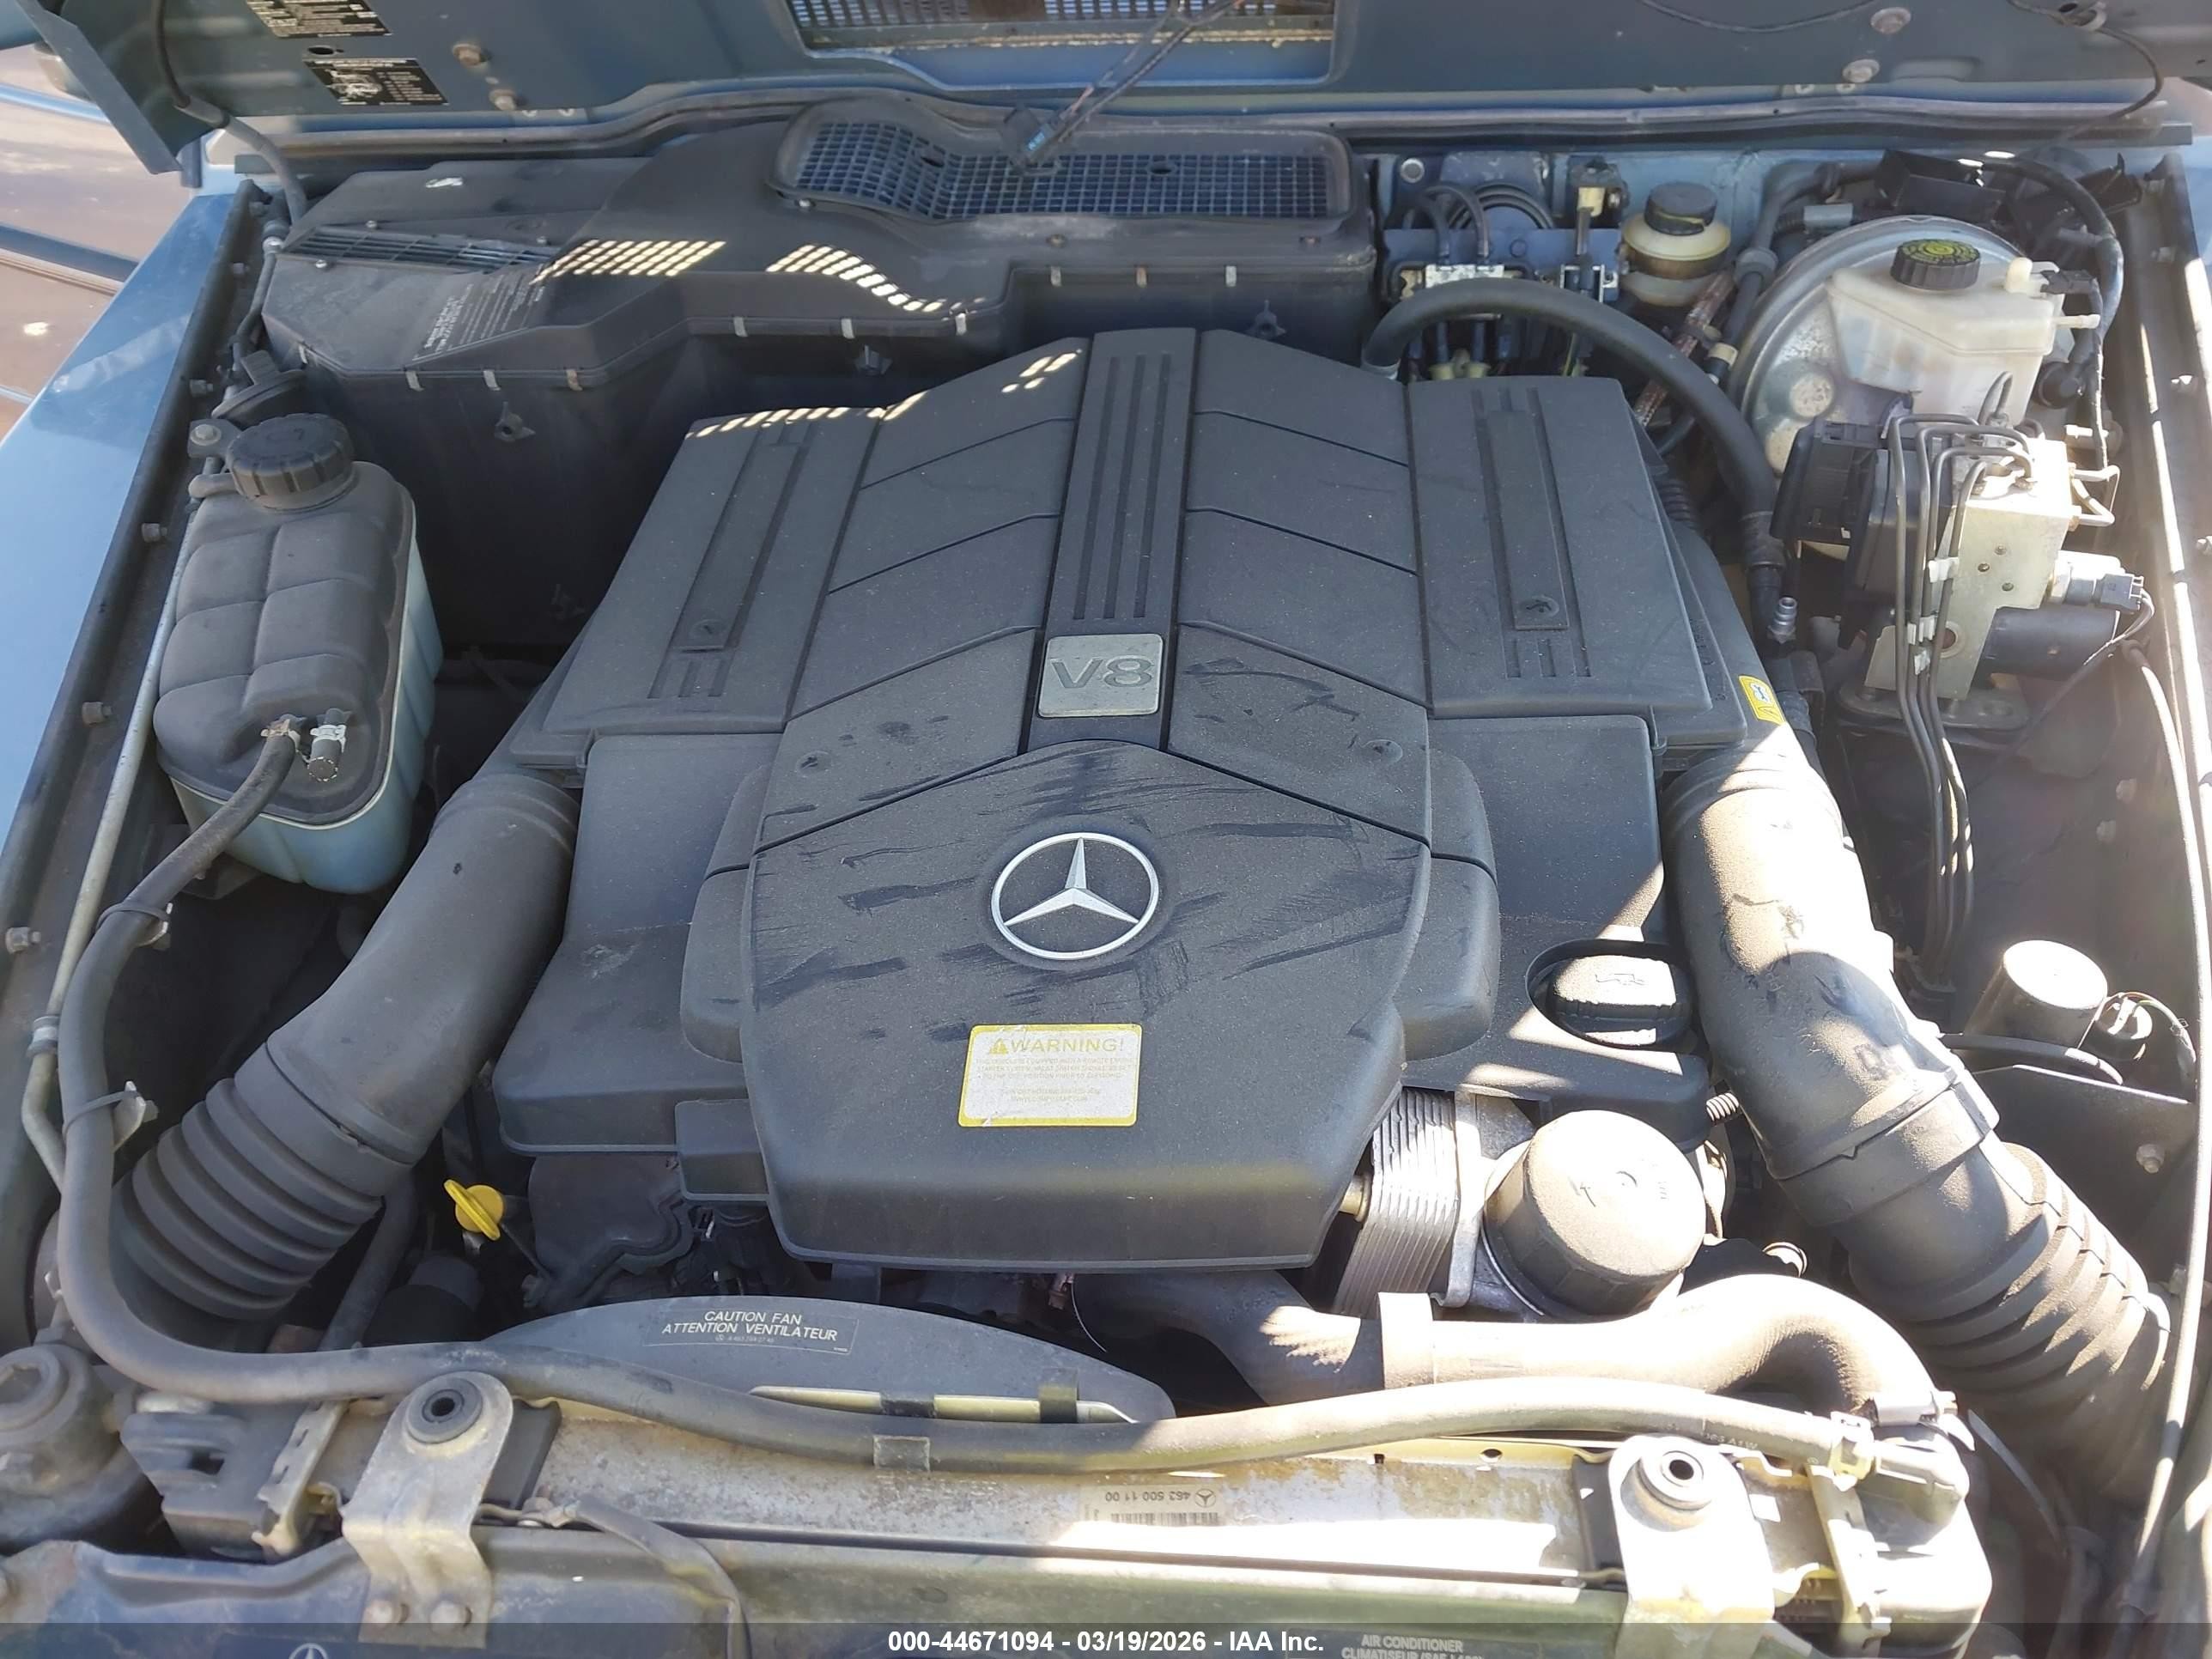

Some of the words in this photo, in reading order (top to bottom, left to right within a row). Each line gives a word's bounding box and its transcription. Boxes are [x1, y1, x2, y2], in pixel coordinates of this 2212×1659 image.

[1049, 654, 1154, 689] V8
[1011, 1037, 1125, 1053] WARNING!
[703, 1310, 767, 1323] CAUTION
[772, 1312, 803, 1325] FAN
[661, 1322, 738, 1334] ATTENTION
[744, 1324, 838, 1341] VENTILATEUR
[1105, 1491, 1121, 1502] 00
[1124, 1491, 1138, 1502] 11
[1142, 1491, 1164, 1502] 500
[1170, 1491, 1191, 1502] 463
[1361, 1634, 1381, 1648] AIR
[1382, 1636, 1463, 1654] CONDITIONER
